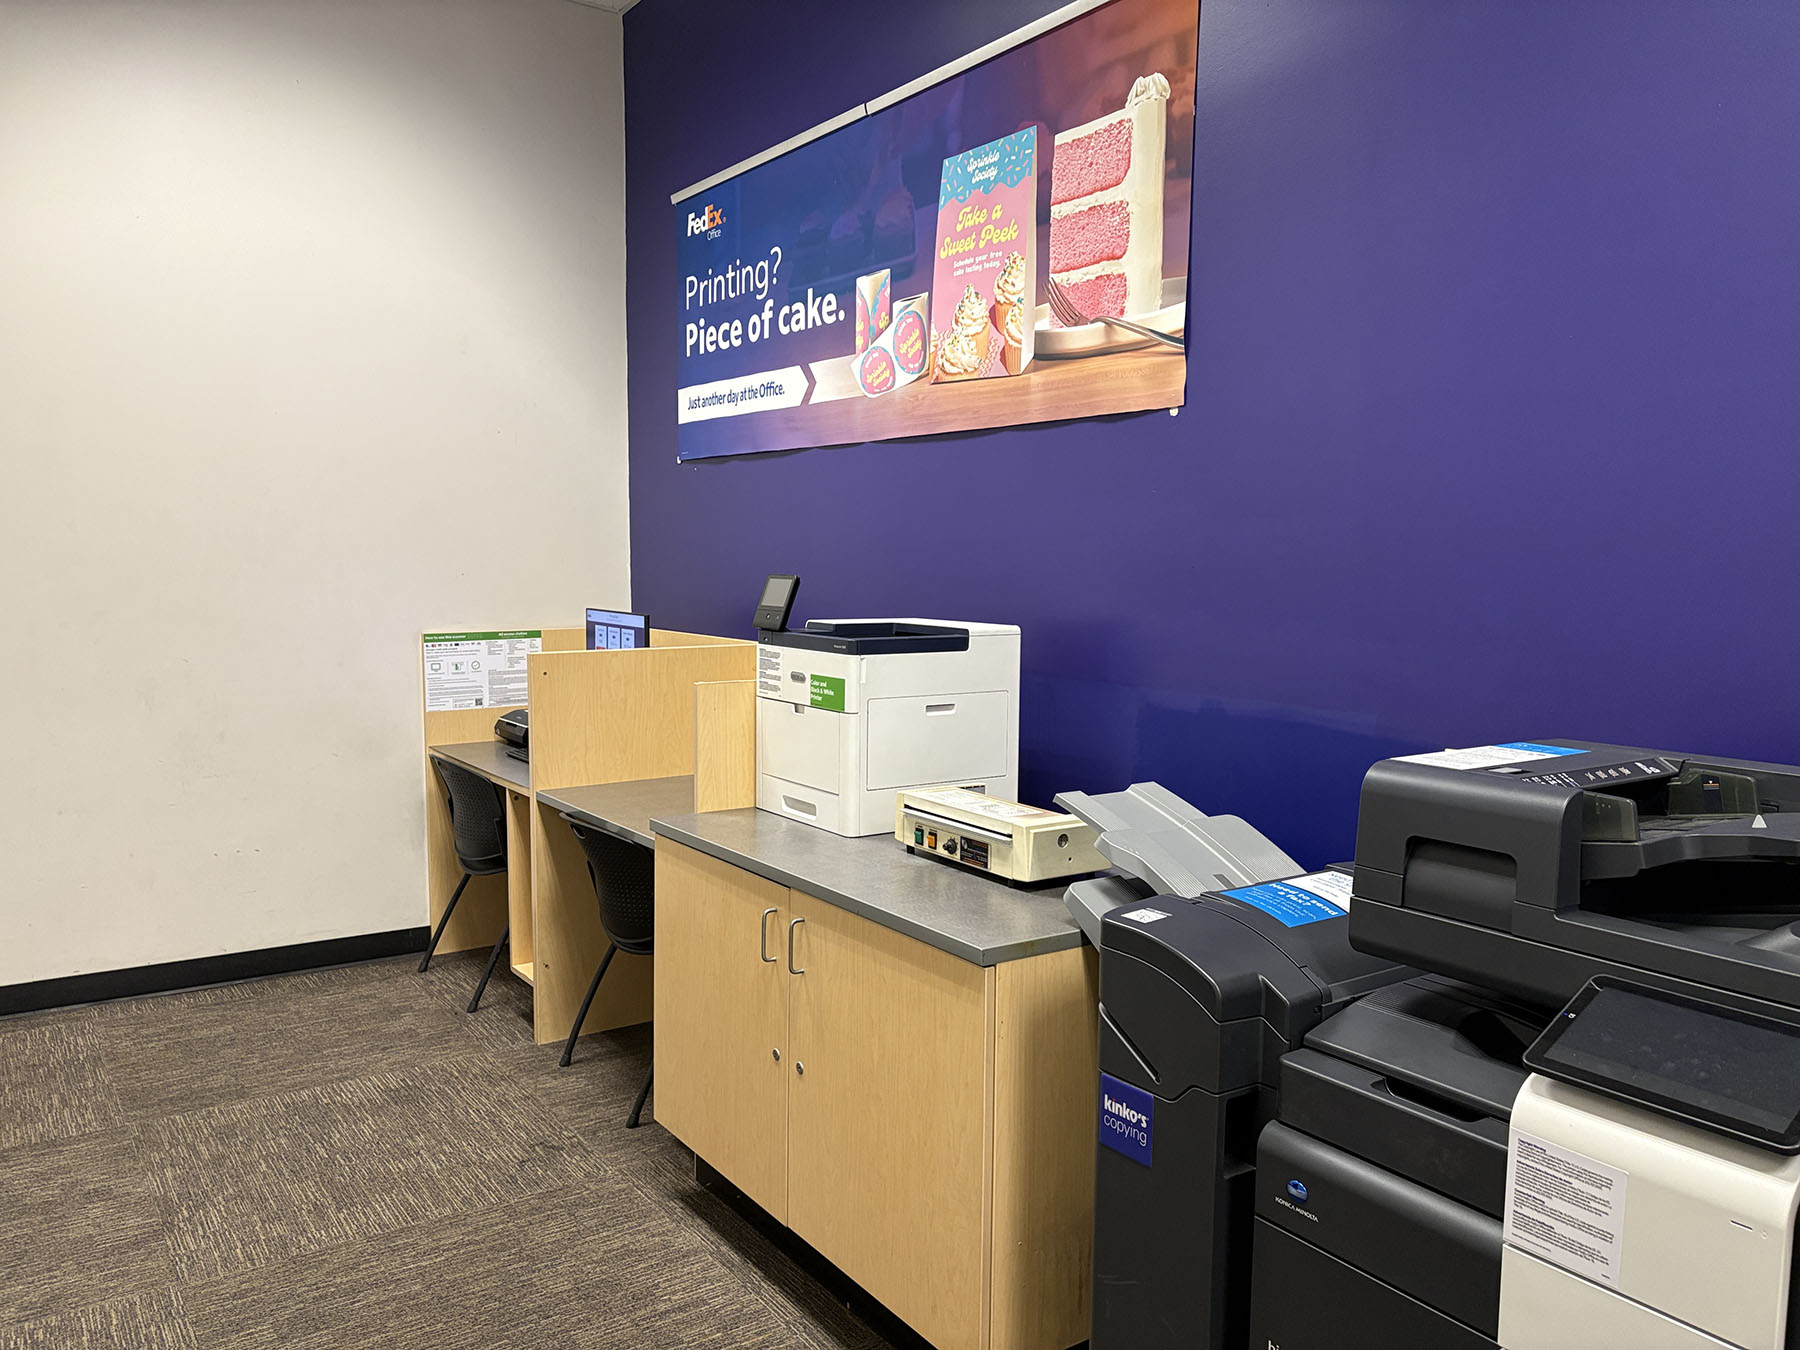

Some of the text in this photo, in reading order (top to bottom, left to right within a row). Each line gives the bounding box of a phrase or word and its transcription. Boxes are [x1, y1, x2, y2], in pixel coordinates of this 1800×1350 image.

[967, 150, 1000, 174] Sprinkle
[972, 166, 999, 184] Society
[956, 203, 1003, 232] Take a
[707, 228, 721, 240] Office
[940, 218, 1019, 259] Sweet Peek
[953, 250, 1003, 268] Schedule your free
[953, 268, 964, 276] cake
[686, 246, 782, 310] Printing?
[686, 318, 743, 358] Piece
[748, 299, 774, 343] of
[778, 288, 845, 335] cake.
[688, 382, 785, 410] Just another day at the Office.
[1269, 883, 1299, 895] Need
[1310, 899, 1339, 916] send
[1286, 894, 1312, 906] fax?
[1104, 1094, 1147, 1128] kinko's
[1104, 1115, 1147, 1147] copying
[1275, 1196, 1318, 1222] KONICA MINOLTA
